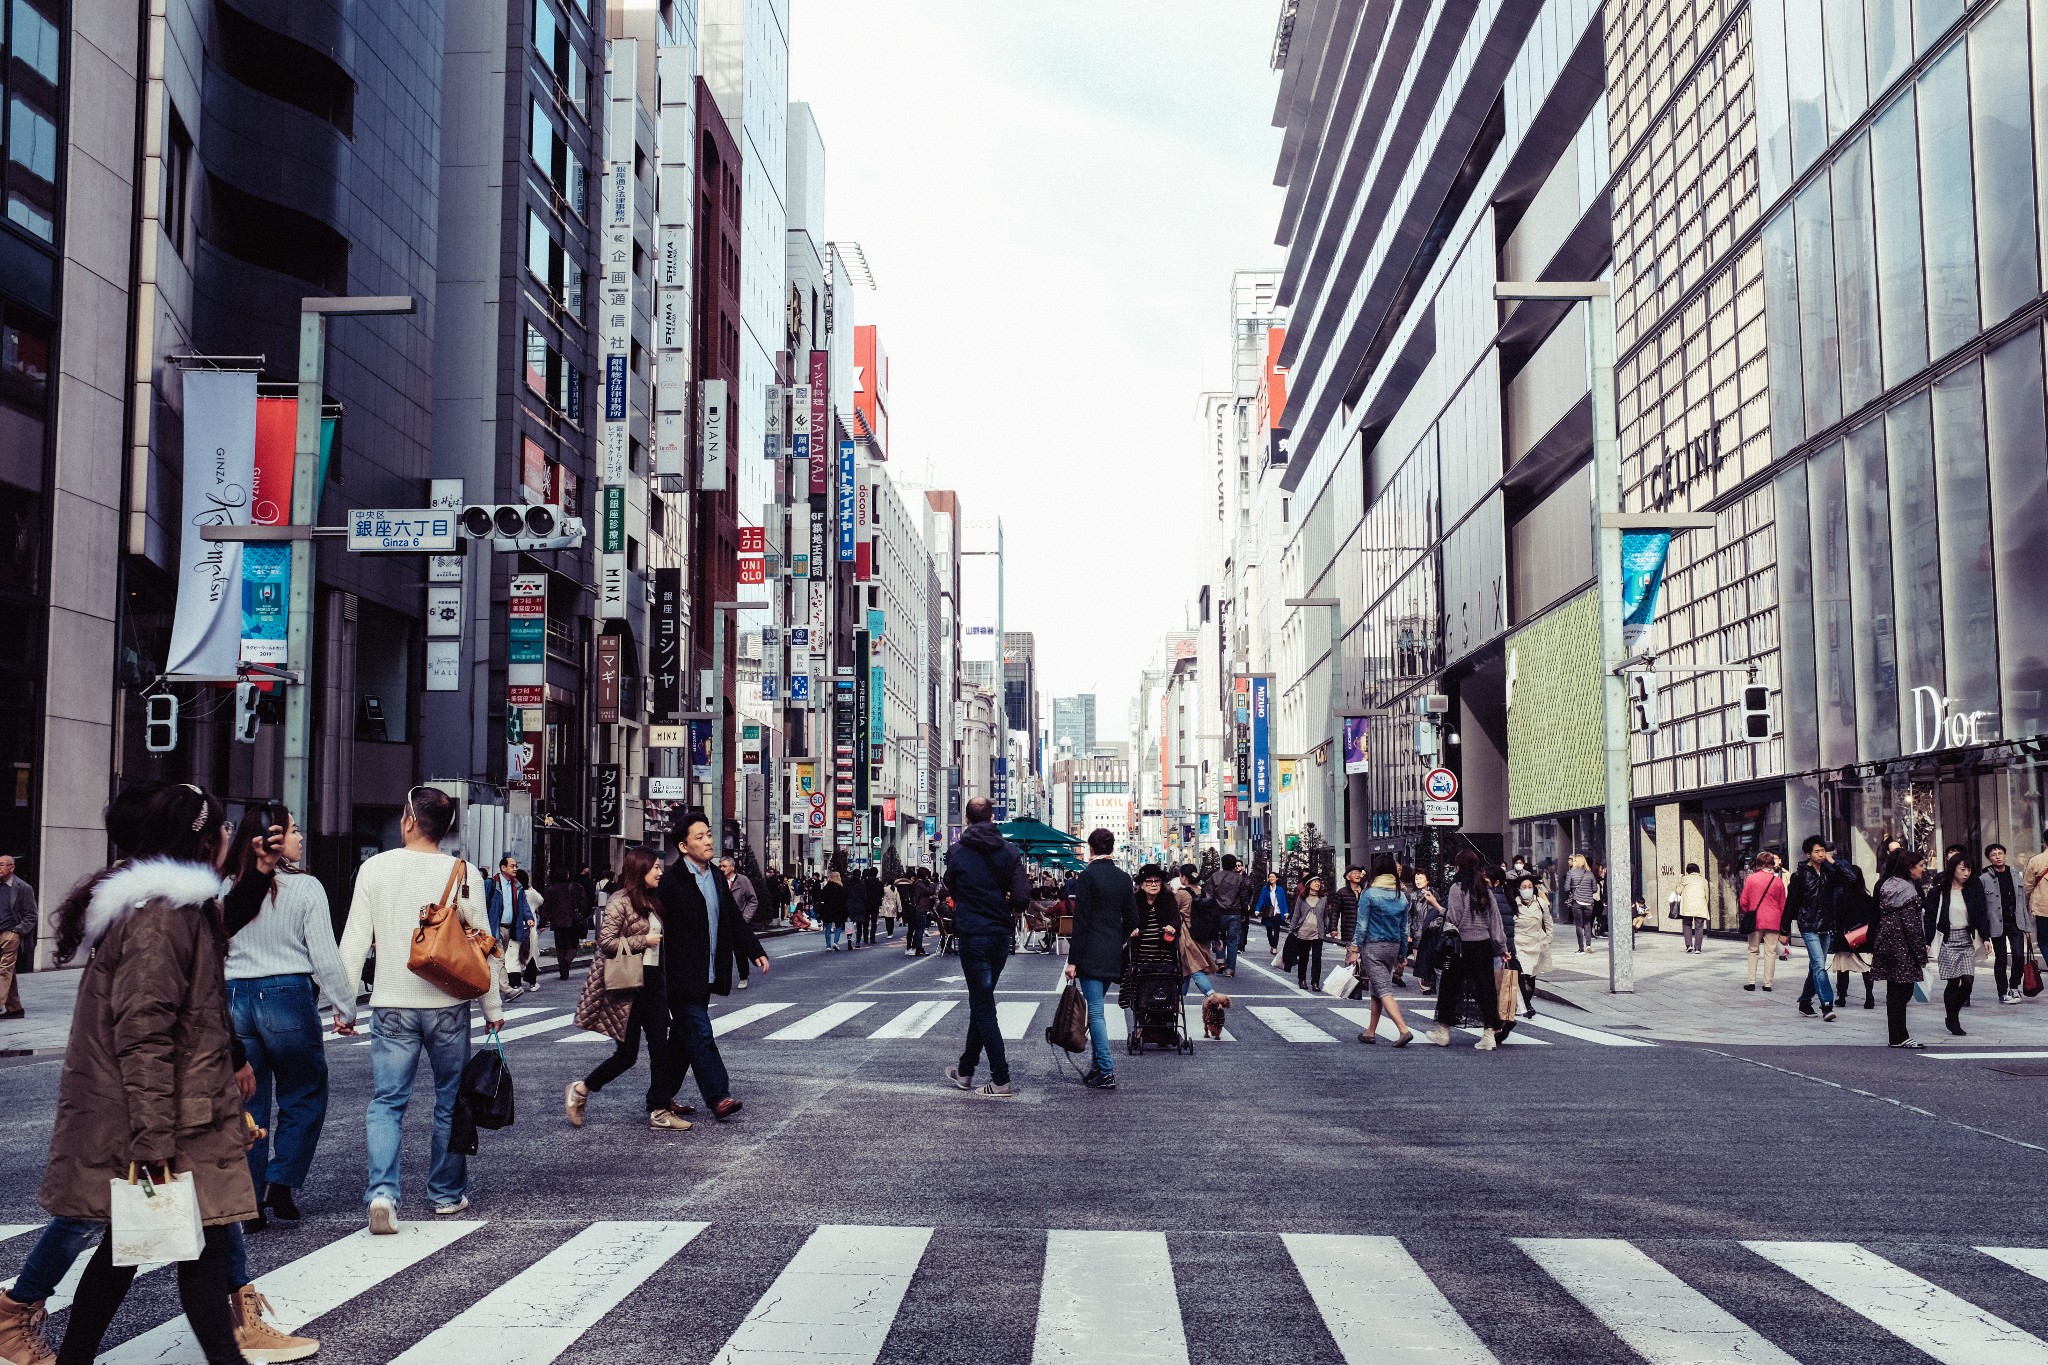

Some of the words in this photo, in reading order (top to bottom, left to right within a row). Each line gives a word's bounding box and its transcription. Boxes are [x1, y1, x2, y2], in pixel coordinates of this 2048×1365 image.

[665, 241, 674, 284] SHIMA
[610, 249, 627, 349] 企画通信社
[664, 302, 673, 346] SHIMA
[610, 358, 623, 417] 銀座総合法律事務所
[812, 362, 825, 406] インド料理
[707, 406, 721, 463] DIANA
[811, 412, 824, 483] NATARAJ
[216, 447, 225, 485] GINZA
[1651, 418, 1723, 509] CÉLINE
[840, 446, 854, 543] アートネイチャー
[859, 484, 868, 526] docomo
[355, 510, 385, 520] 中央区
[355, 519, 448, 537] 銀座六丁目
[608, 488, 620, 550] 西銀座診療所
[811, 512, 824, 520] 6F
[382, 537, 409, 548] Ginza
[412, 537, 420, 547] 6
[742, 529, 762, 539] ユニ
[742, 540, 762, 549] クロ
[741, 560, 761, 570] UNI
[841, 549, 853, 557] 6F
[605, 569, 620, 602] MINX
[741, 571, 762, 581] QLO
[429, 607, 435, 616] 6
[662, 591, 673, 614] 銀座
[965, 626, 995, 635] 山野楽器
[659, 619, 675, 689] ヨシノヤ
[601, 655, 616, 700] マギー
[1257, 686, 1265, 718] MIZUHO
[1910, 685, 1987, 754] Dior
[657, 731, 677, 741] MINX
[1008, 737, 1016, 778] 教文館
[1257, 758, 1266, 794] みずほ銀行
[600, 769, 617, 829] タカゲン
[813, 796, 824, 804] 50
[1095, 798, 1124, 807] LIXIL
